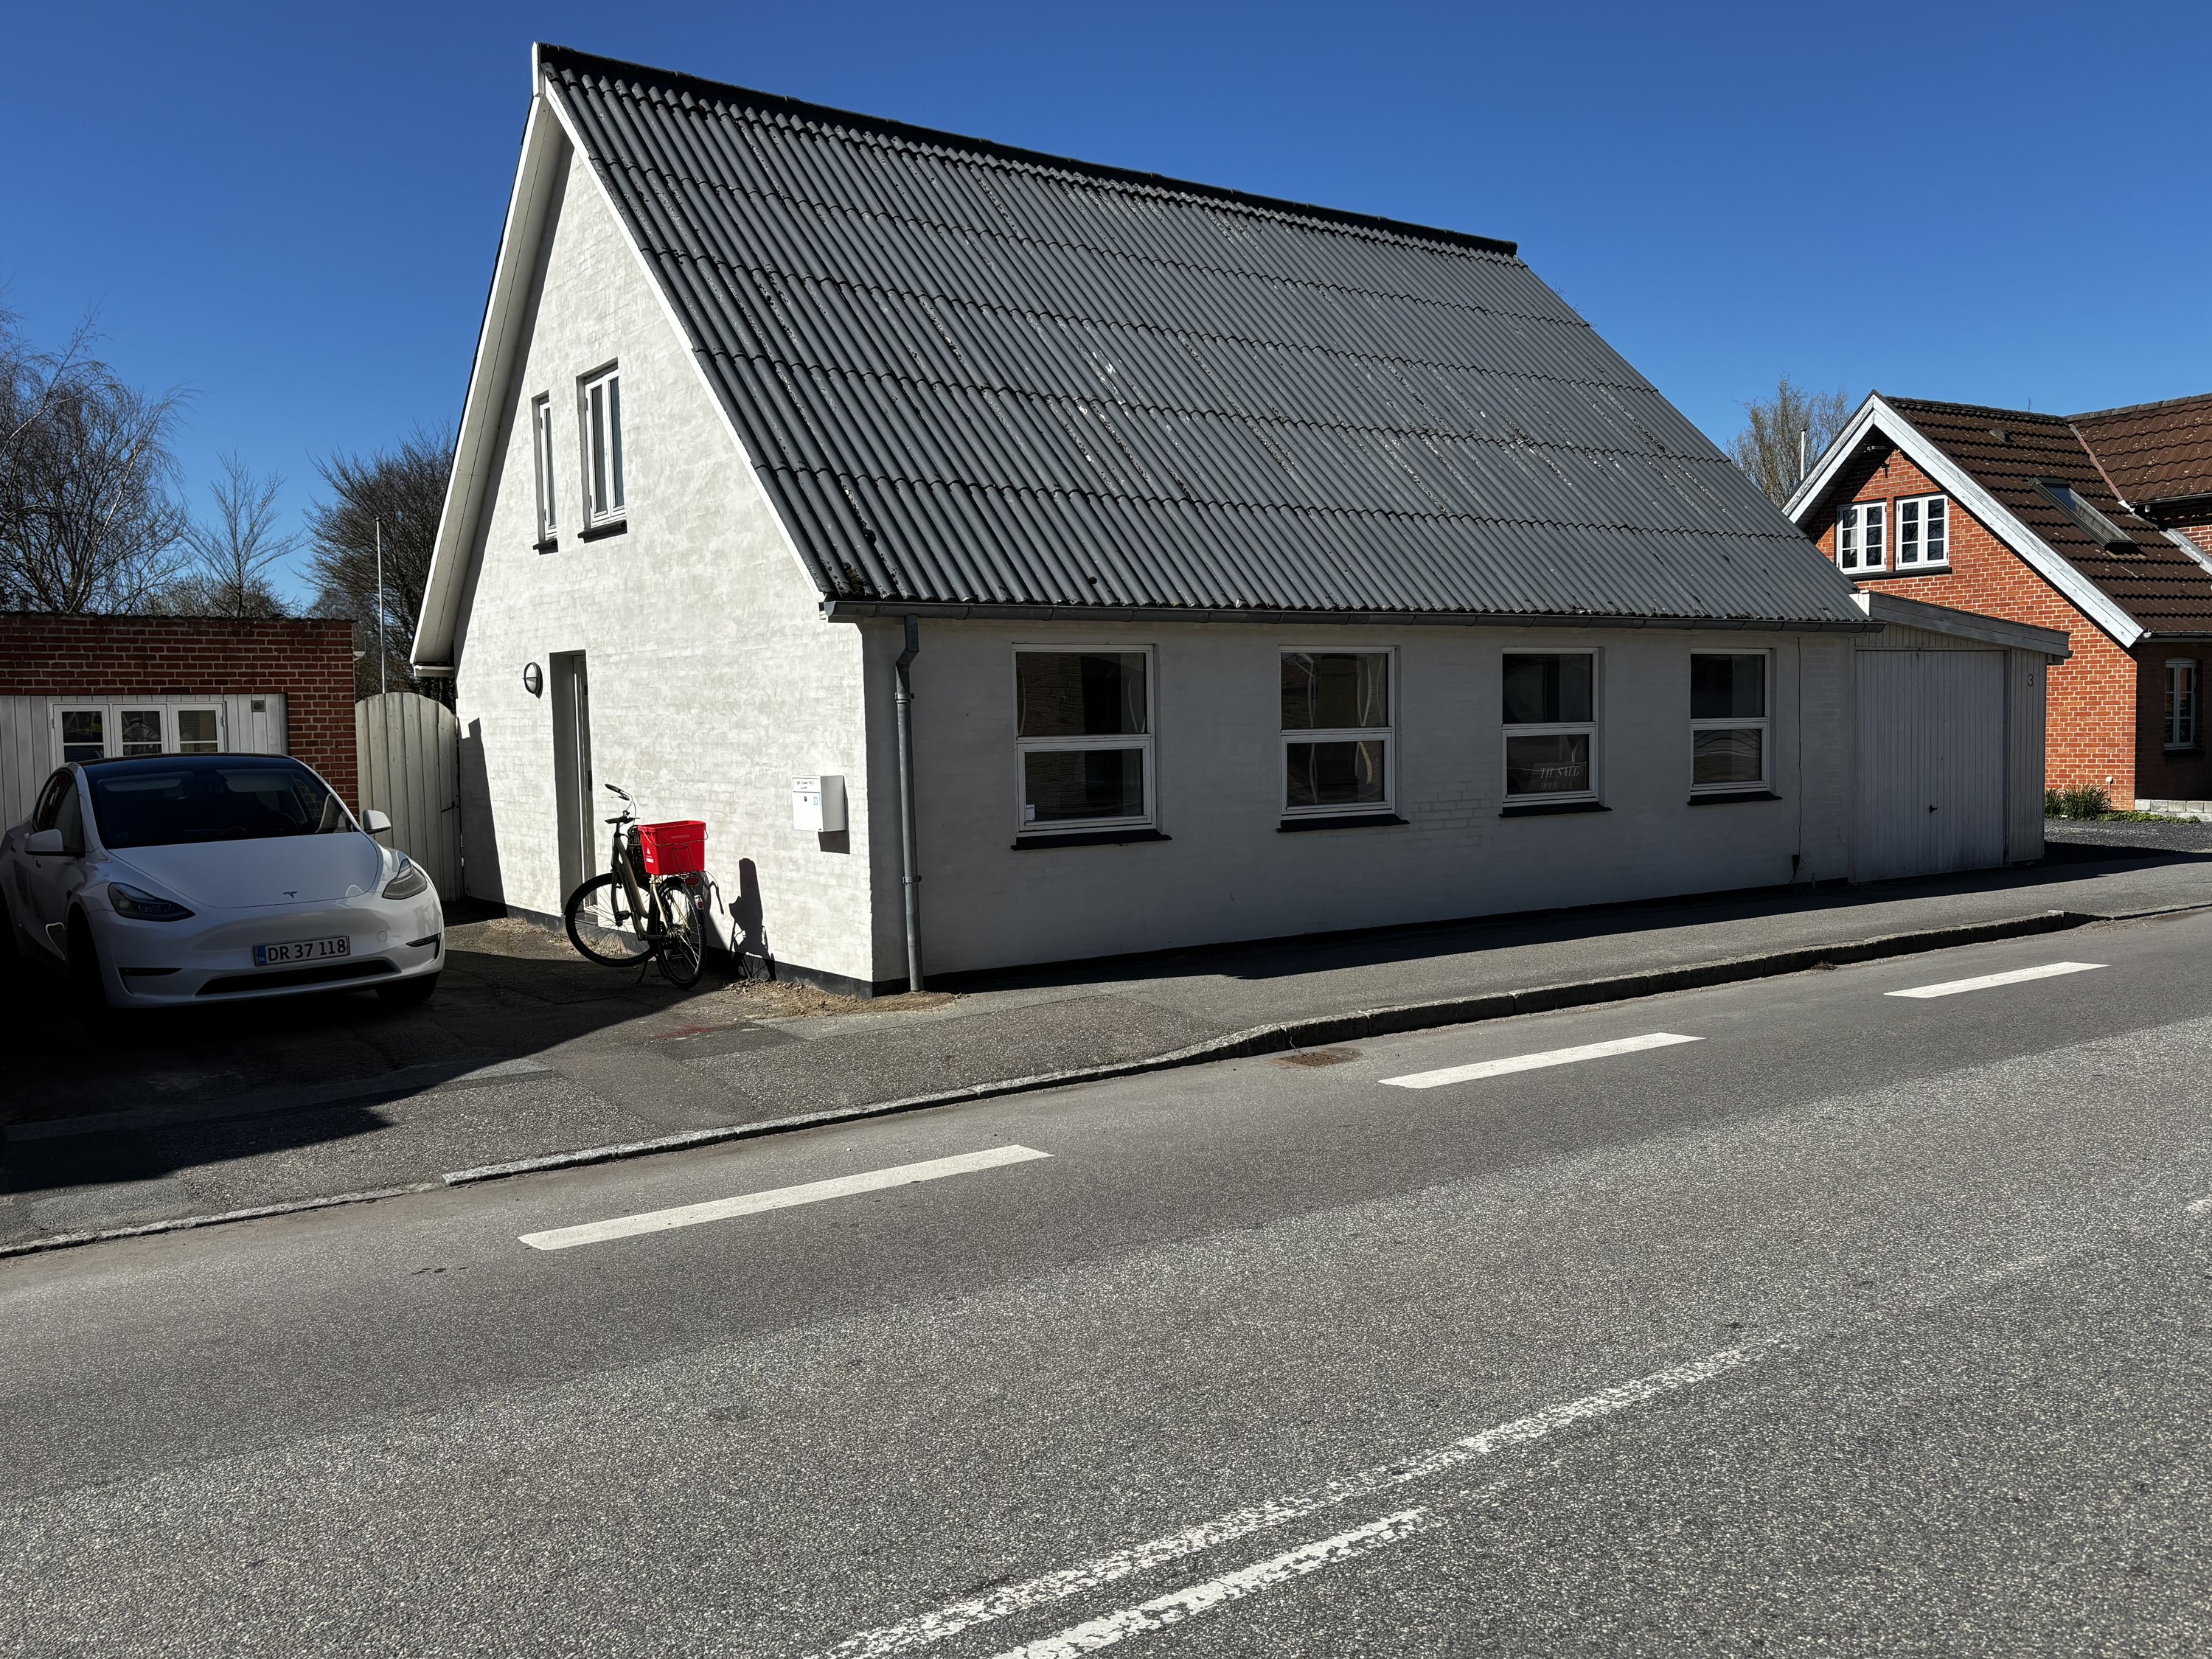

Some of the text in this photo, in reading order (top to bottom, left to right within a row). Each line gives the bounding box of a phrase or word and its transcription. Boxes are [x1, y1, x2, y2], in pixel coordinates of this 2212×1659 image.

[2027, 673, 2034, 686] 3
[268, 939, 347, 961] DR 37 118
